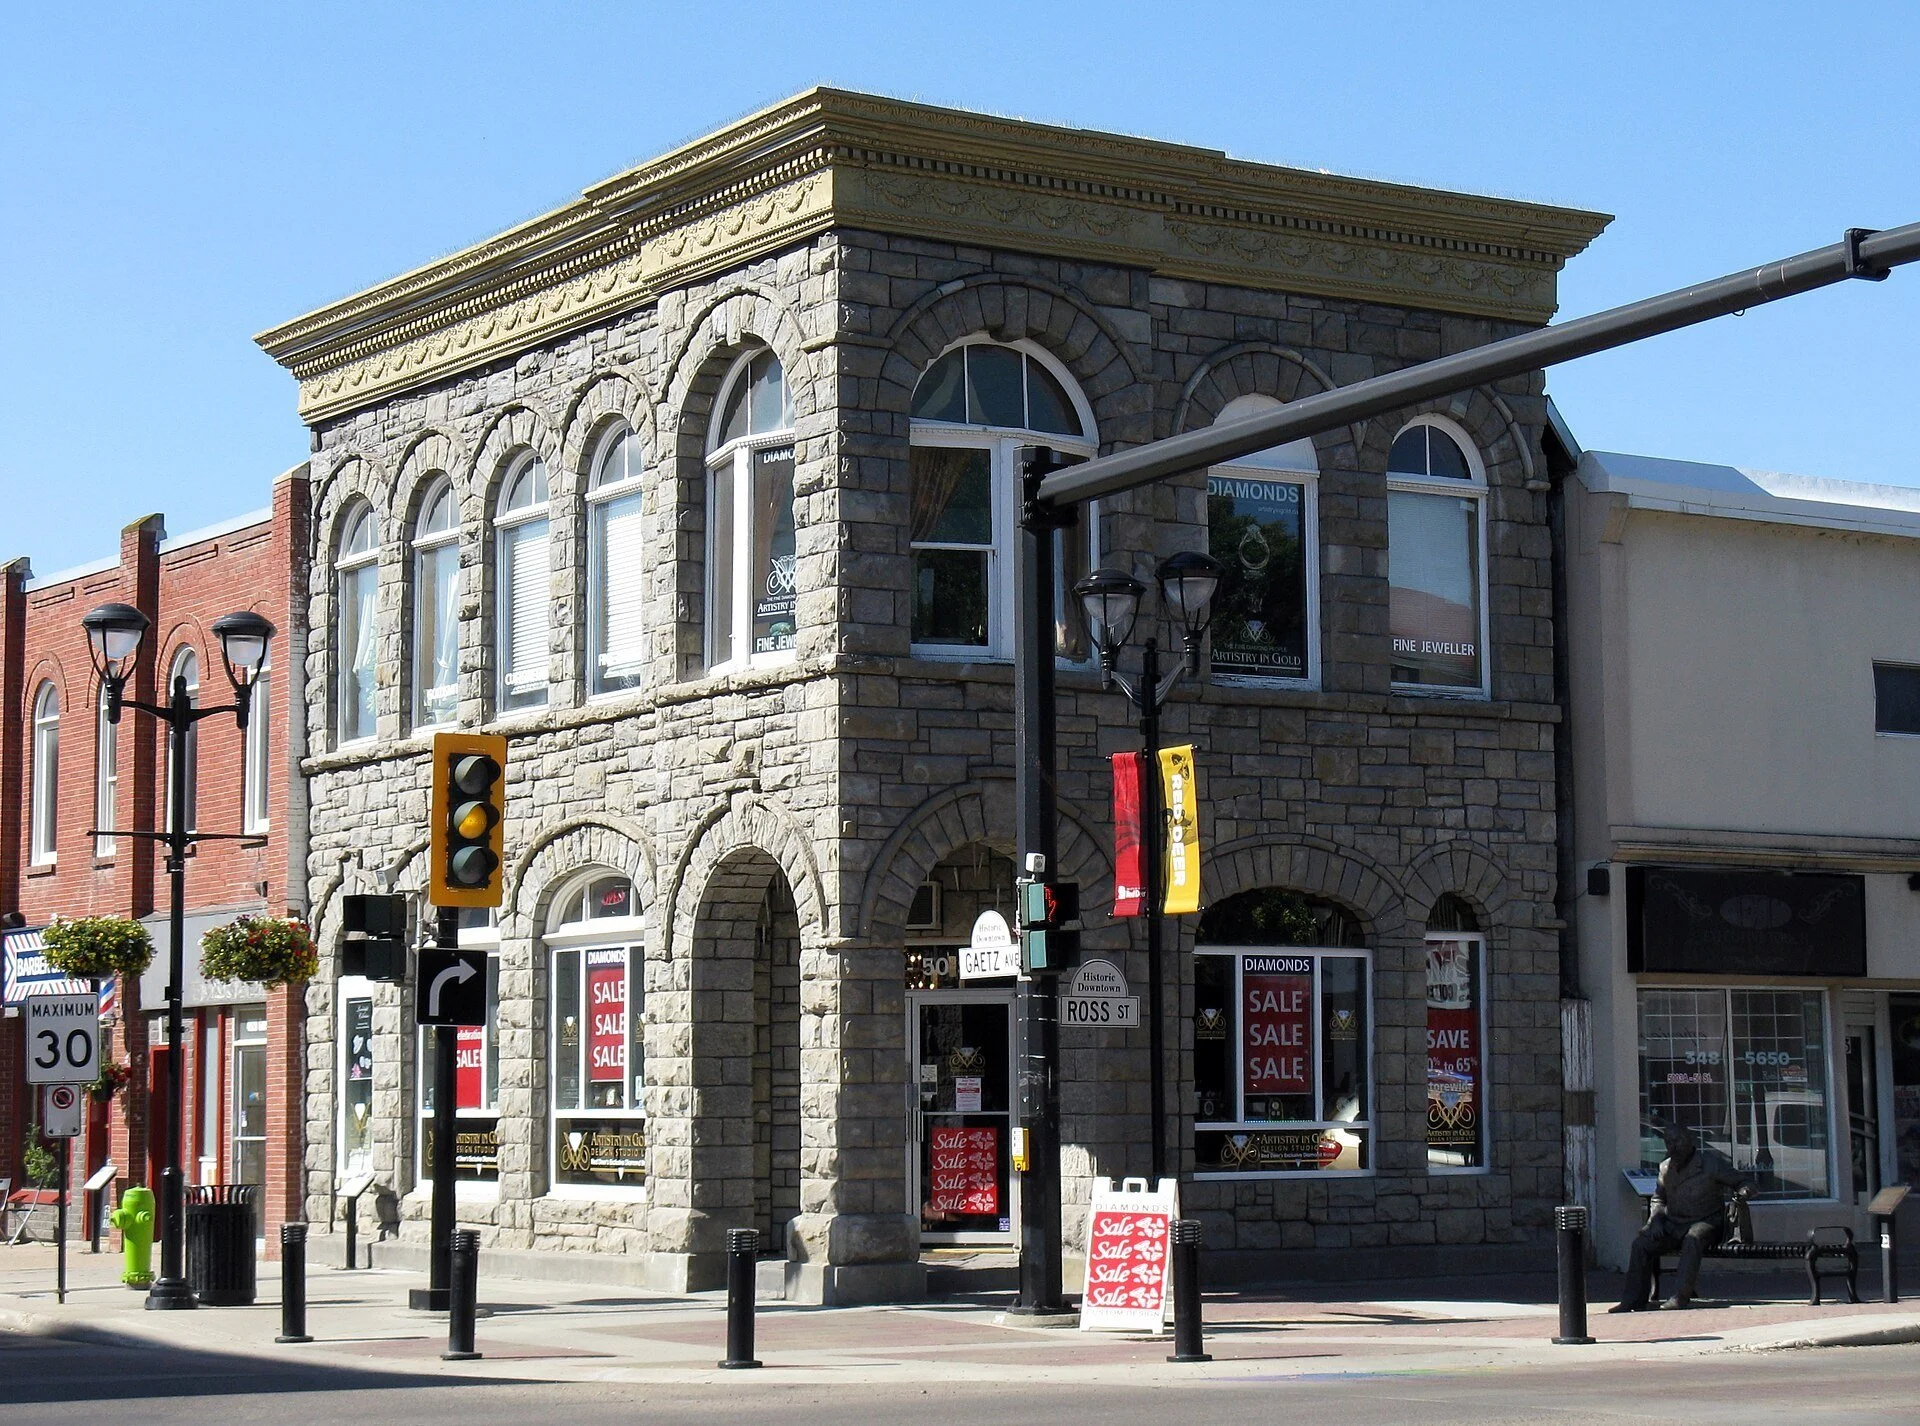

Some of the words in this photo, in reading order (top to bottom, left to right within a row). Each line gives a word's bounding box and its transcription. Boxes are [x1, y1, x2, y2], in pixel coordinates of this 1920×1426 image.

[1207, 479, 1299, 503] DIAMONDS
[756, 636, 775, 652] FINE
[1393, 638, 1416, 652] FINE
[1420, 640, 1475, 656] JEWELLER
[1211, 648, 1257, 663] ARTISTRY
[1259, 654, 1269, 663] IN
[1271, 652, 1301, 666] GOLD
[1171, 773, 1183, 820] RED
[1171, 825, 1186, 887] DEER
[588, 949, 625, 964] DIAMONDS
[965, 951, 1000, 973] GAETZ
[1005, 952, 1018, 968] AVE
[1245, 958, 1309, 972] DIAMONDS
[1083, 972, 1116, 982] Historic
[593, 980, 624, 1004] SALE
[1078, 983, 1121, 993] Downtown
[32, 1003, 94, 1018] MAXIMUM
[1067, 1000, 1110, 1022] ROSS
[1117, 1004, 1130, 1019] ST
[1249, 990, 1303, 1013] SALE
[594, 1012, 624, 1035] SALE
[1249, 1023, 1303, 1046] SALE
[1427, 1029, 1470, 1049] SAVE
[34, 1028, 92, 1069] 30
[592, 1045, 624, 1067] SALE
[1444, 1061, 1454, 1072] to
[1456, 1057, 1477, 1073] 65%
[1684, 1051, 1721, 1065] 348
[1745, 1051, 1790, 1066] 5650
[1250, 1057, 1304, 1080] SALE
[591, 1132, 622, 1147] ARTISTRY
[623, 1136, 632, 1147] IN
[933, 1131, 967, 1150] Sale
[1260, 1134, 1301, 1144] ARTISTRY
[1301, 1135, 1310, 1144] IN
[474, 1145, 495, 1153] STUDIO
[615, 1149, 638, 1157] STUDIO
[933, 1152, 967, 1170] Sale
[933, 1172, 967, 1191] Sale
[933, 1193, 967, 1211] Sale
[1095, 1203, 1169, 1213] DIAMONDS
[1093, 1215, 1135, 1237] Sale
[1091, 1239, 1133, 1260] Sale
[1089, 1262, 1131, 1283] Sale
[1087, 1285, 1128, 1307] Sale
